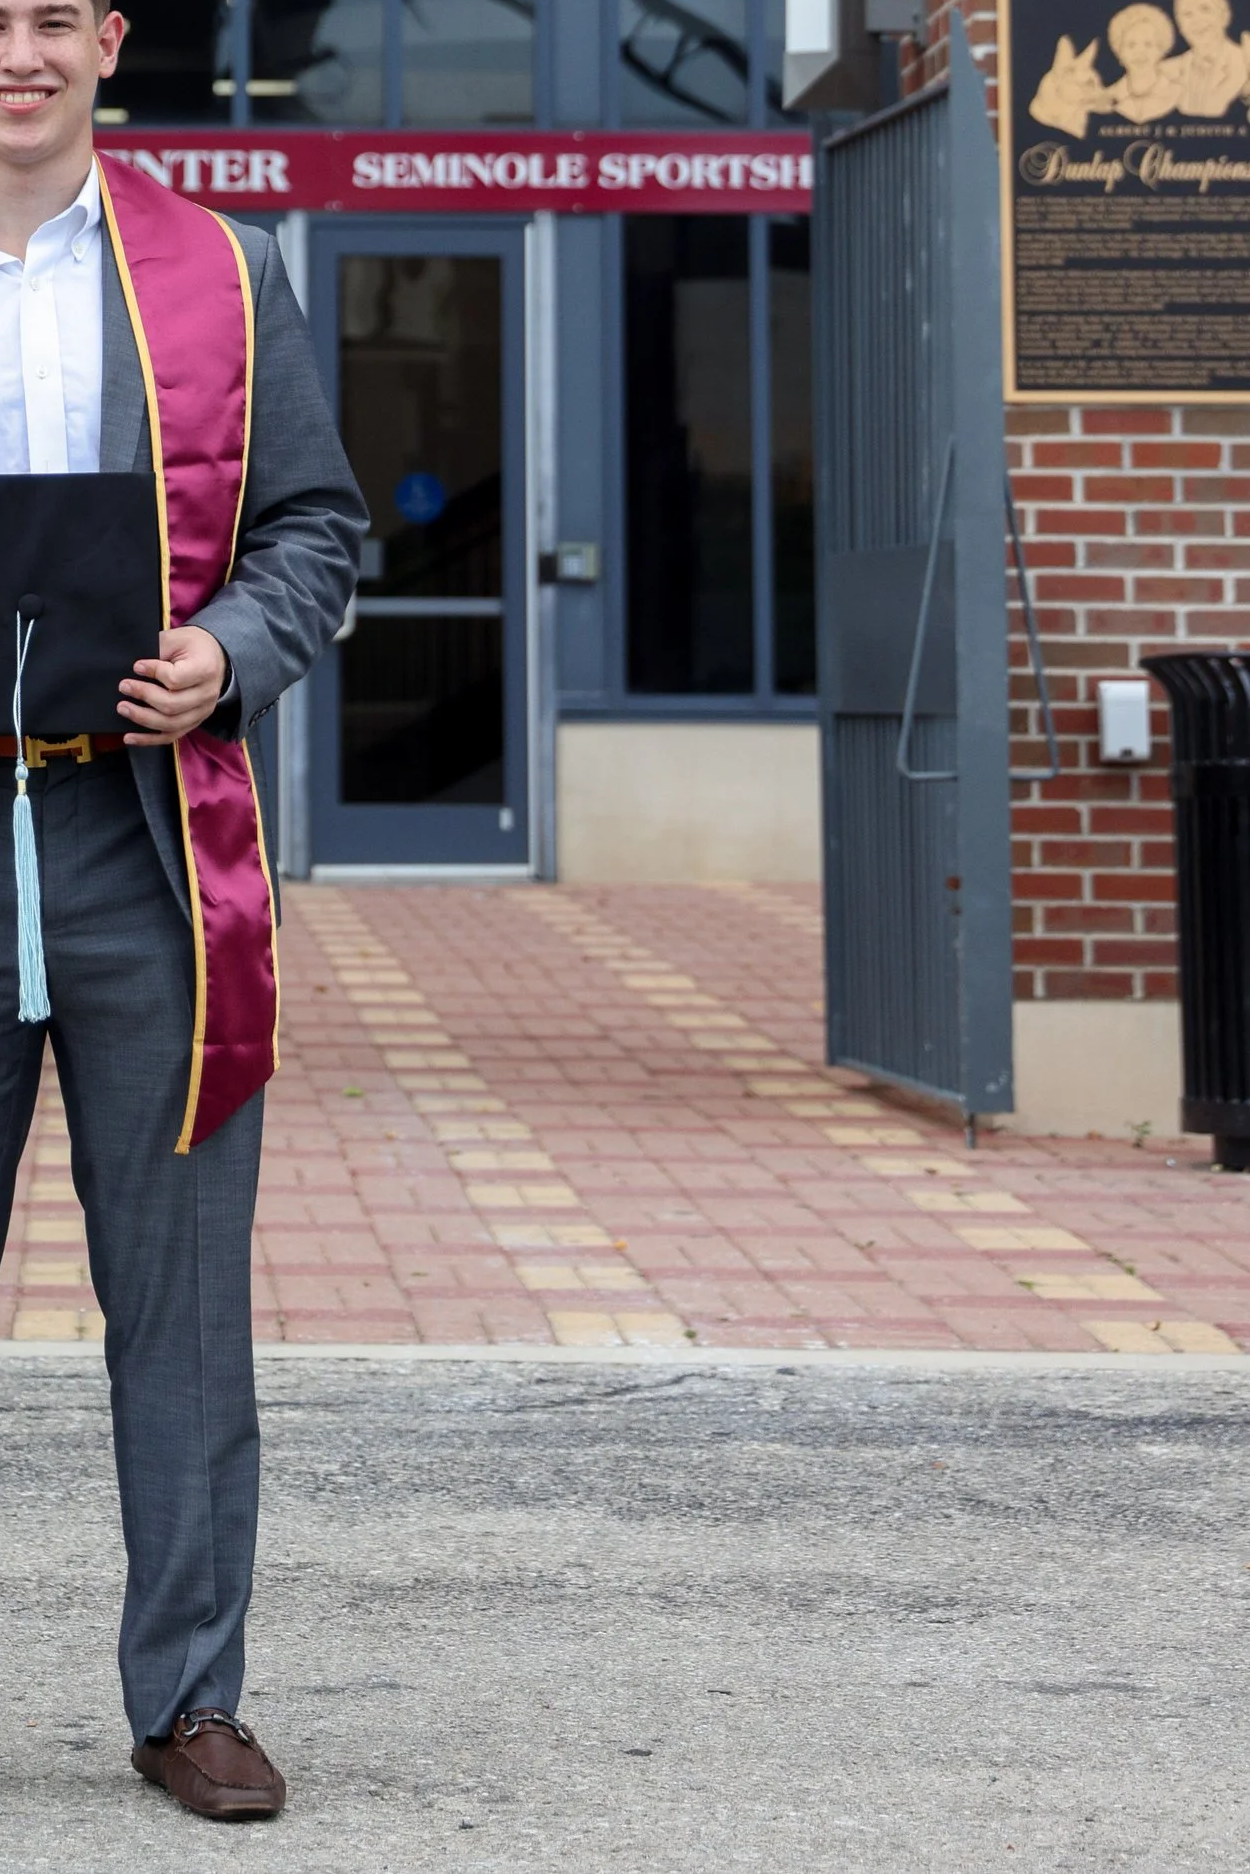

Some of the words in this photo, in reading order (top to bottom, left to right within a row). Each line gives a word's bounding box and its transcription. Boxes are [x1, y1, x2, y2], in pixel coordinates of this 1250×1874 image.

[102, 148, 291, 193] NTER
[352, 151, 589, 190] SEMINOLE
[597, 153, 815, 191] SPORTSH
[1019, 141, 1126, 193] Dunlap
